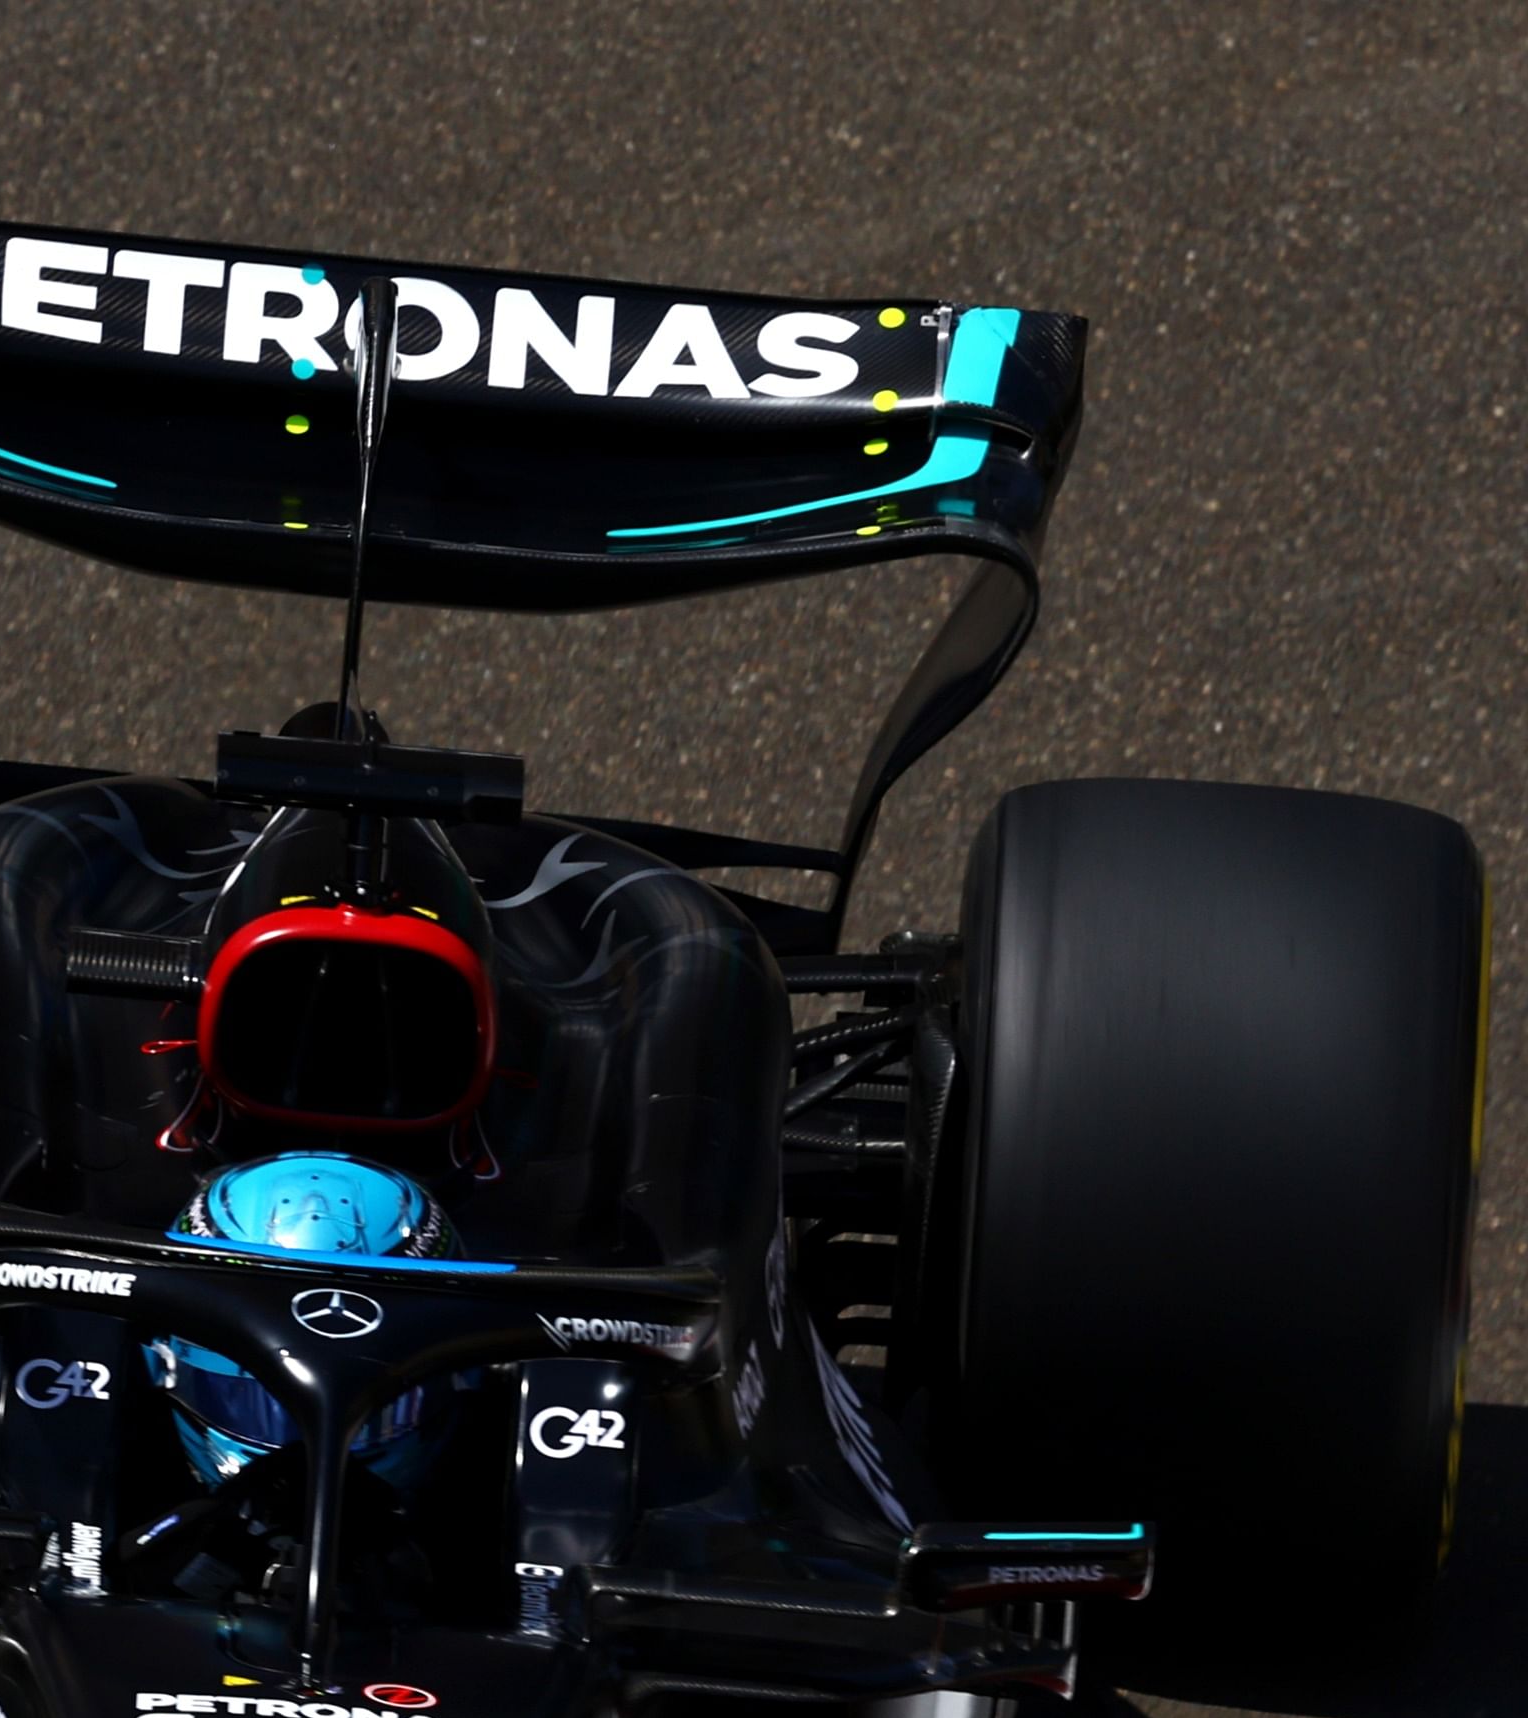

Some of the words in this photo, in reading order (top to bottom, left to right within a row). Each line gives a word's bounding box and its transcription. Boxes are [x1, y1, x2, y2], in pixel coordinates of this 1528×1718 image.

[14, 1357, 112, 1410] G42
[528, 1405, 626, 1459] G42
[987, 1563, 1104, 1585] PETRONAS
